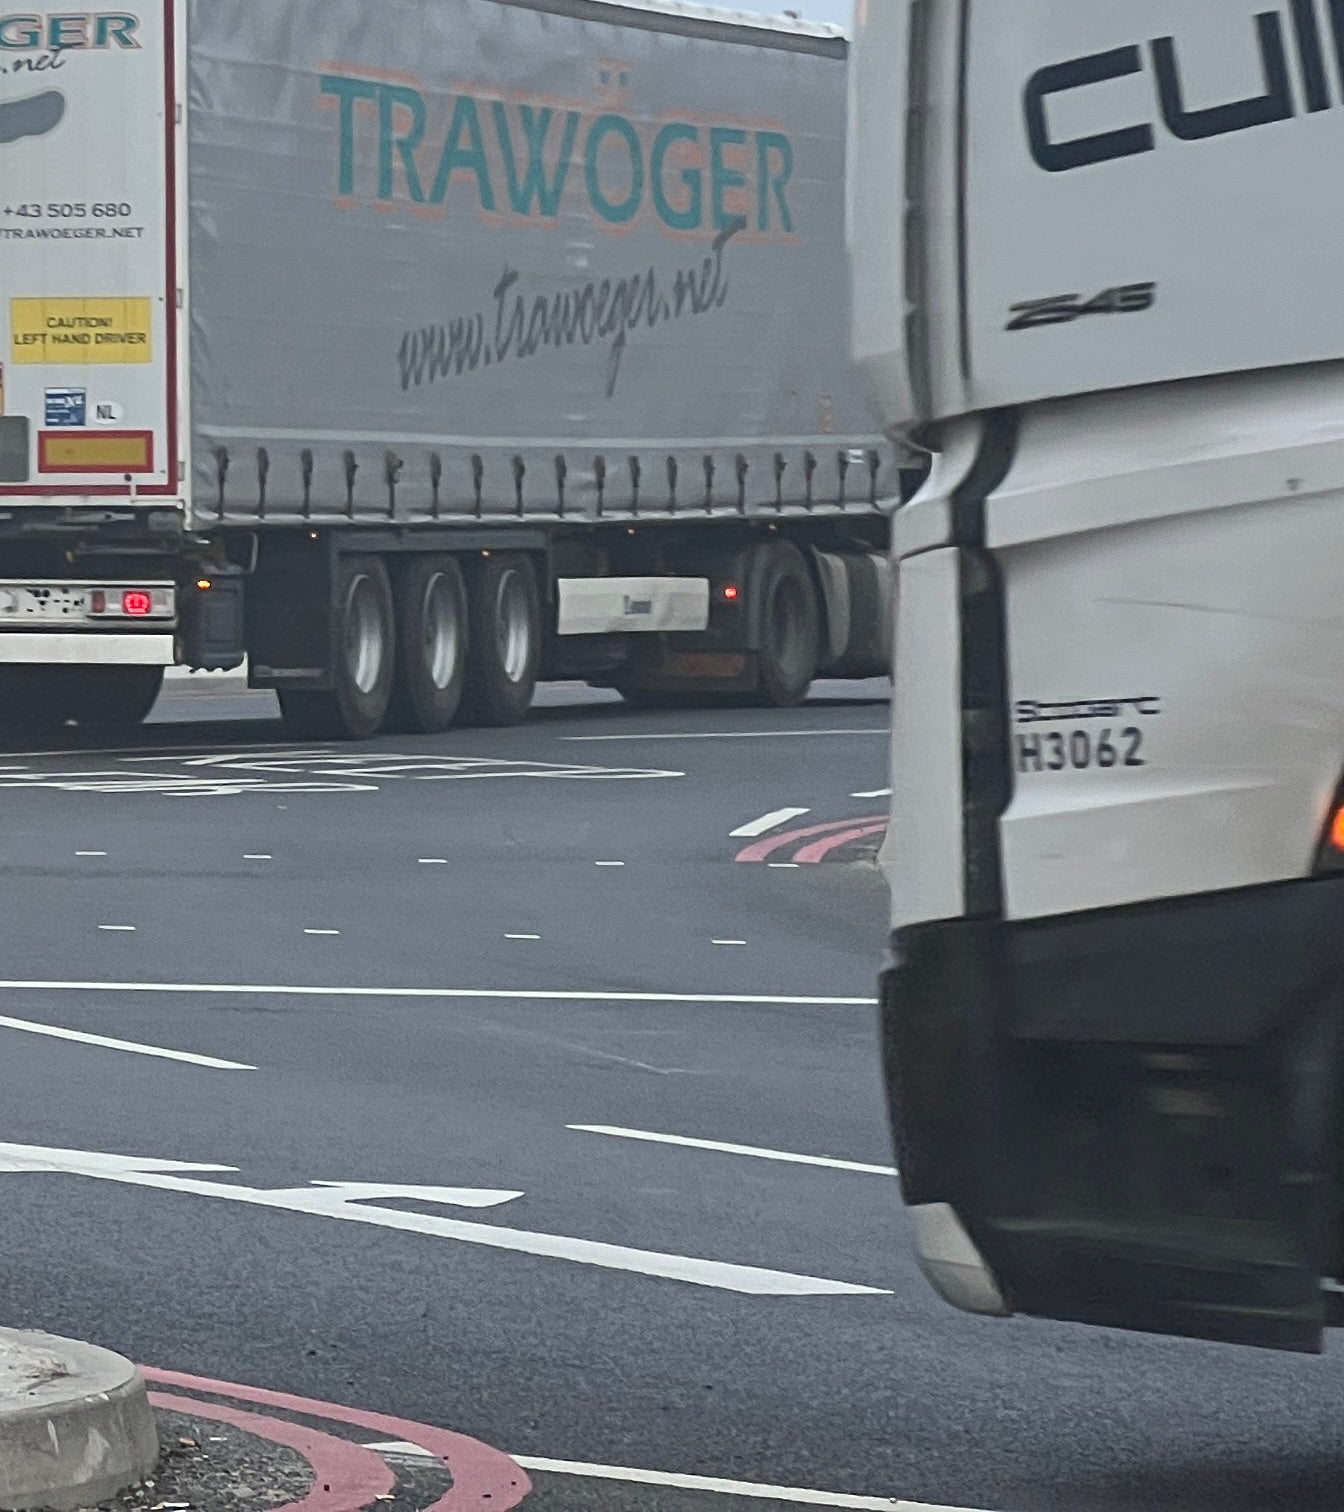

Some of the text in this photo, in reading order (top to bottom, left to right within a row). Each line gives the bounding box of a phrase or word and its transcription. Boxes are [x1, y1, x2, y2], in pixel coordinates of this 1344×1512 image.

[315, 60, 798, 238] TRAWÖGER
[47, 203, 87, 218] 505
[92, 202, 132, 217] 680
[14, 332, 147, 345] LEFT HAND DRIVER
[117, 749, 686, 780] KEEP
[1015, 726, 1145, 772] H3062
